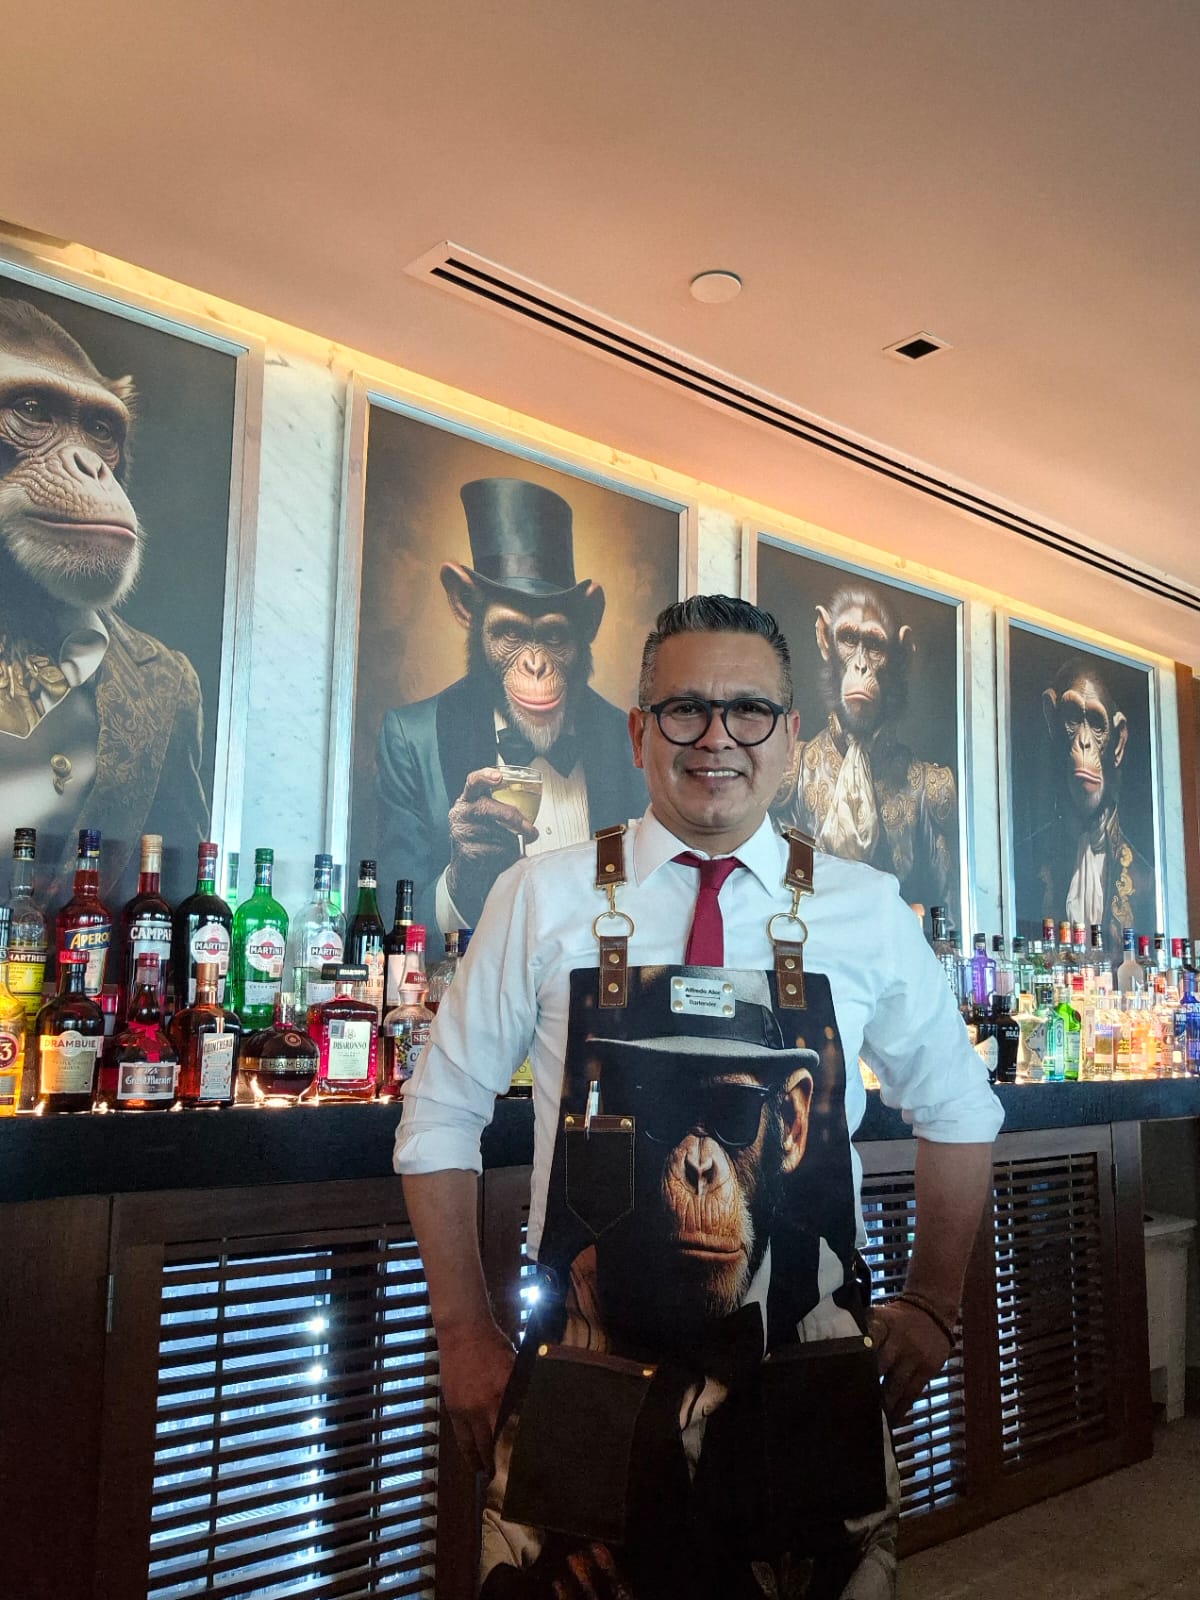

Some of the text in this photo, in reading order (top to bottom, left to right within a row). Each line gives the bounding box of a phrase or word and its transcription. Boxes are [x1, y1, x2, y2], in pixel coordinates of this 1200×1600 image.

[70, 932, 109, 949] APERO
[44, 1039, 97, 1049] DRAMBUIE
[333, 1041, 367, 1050] DISARONNO
[0, 1042, 13, 1061] 3
